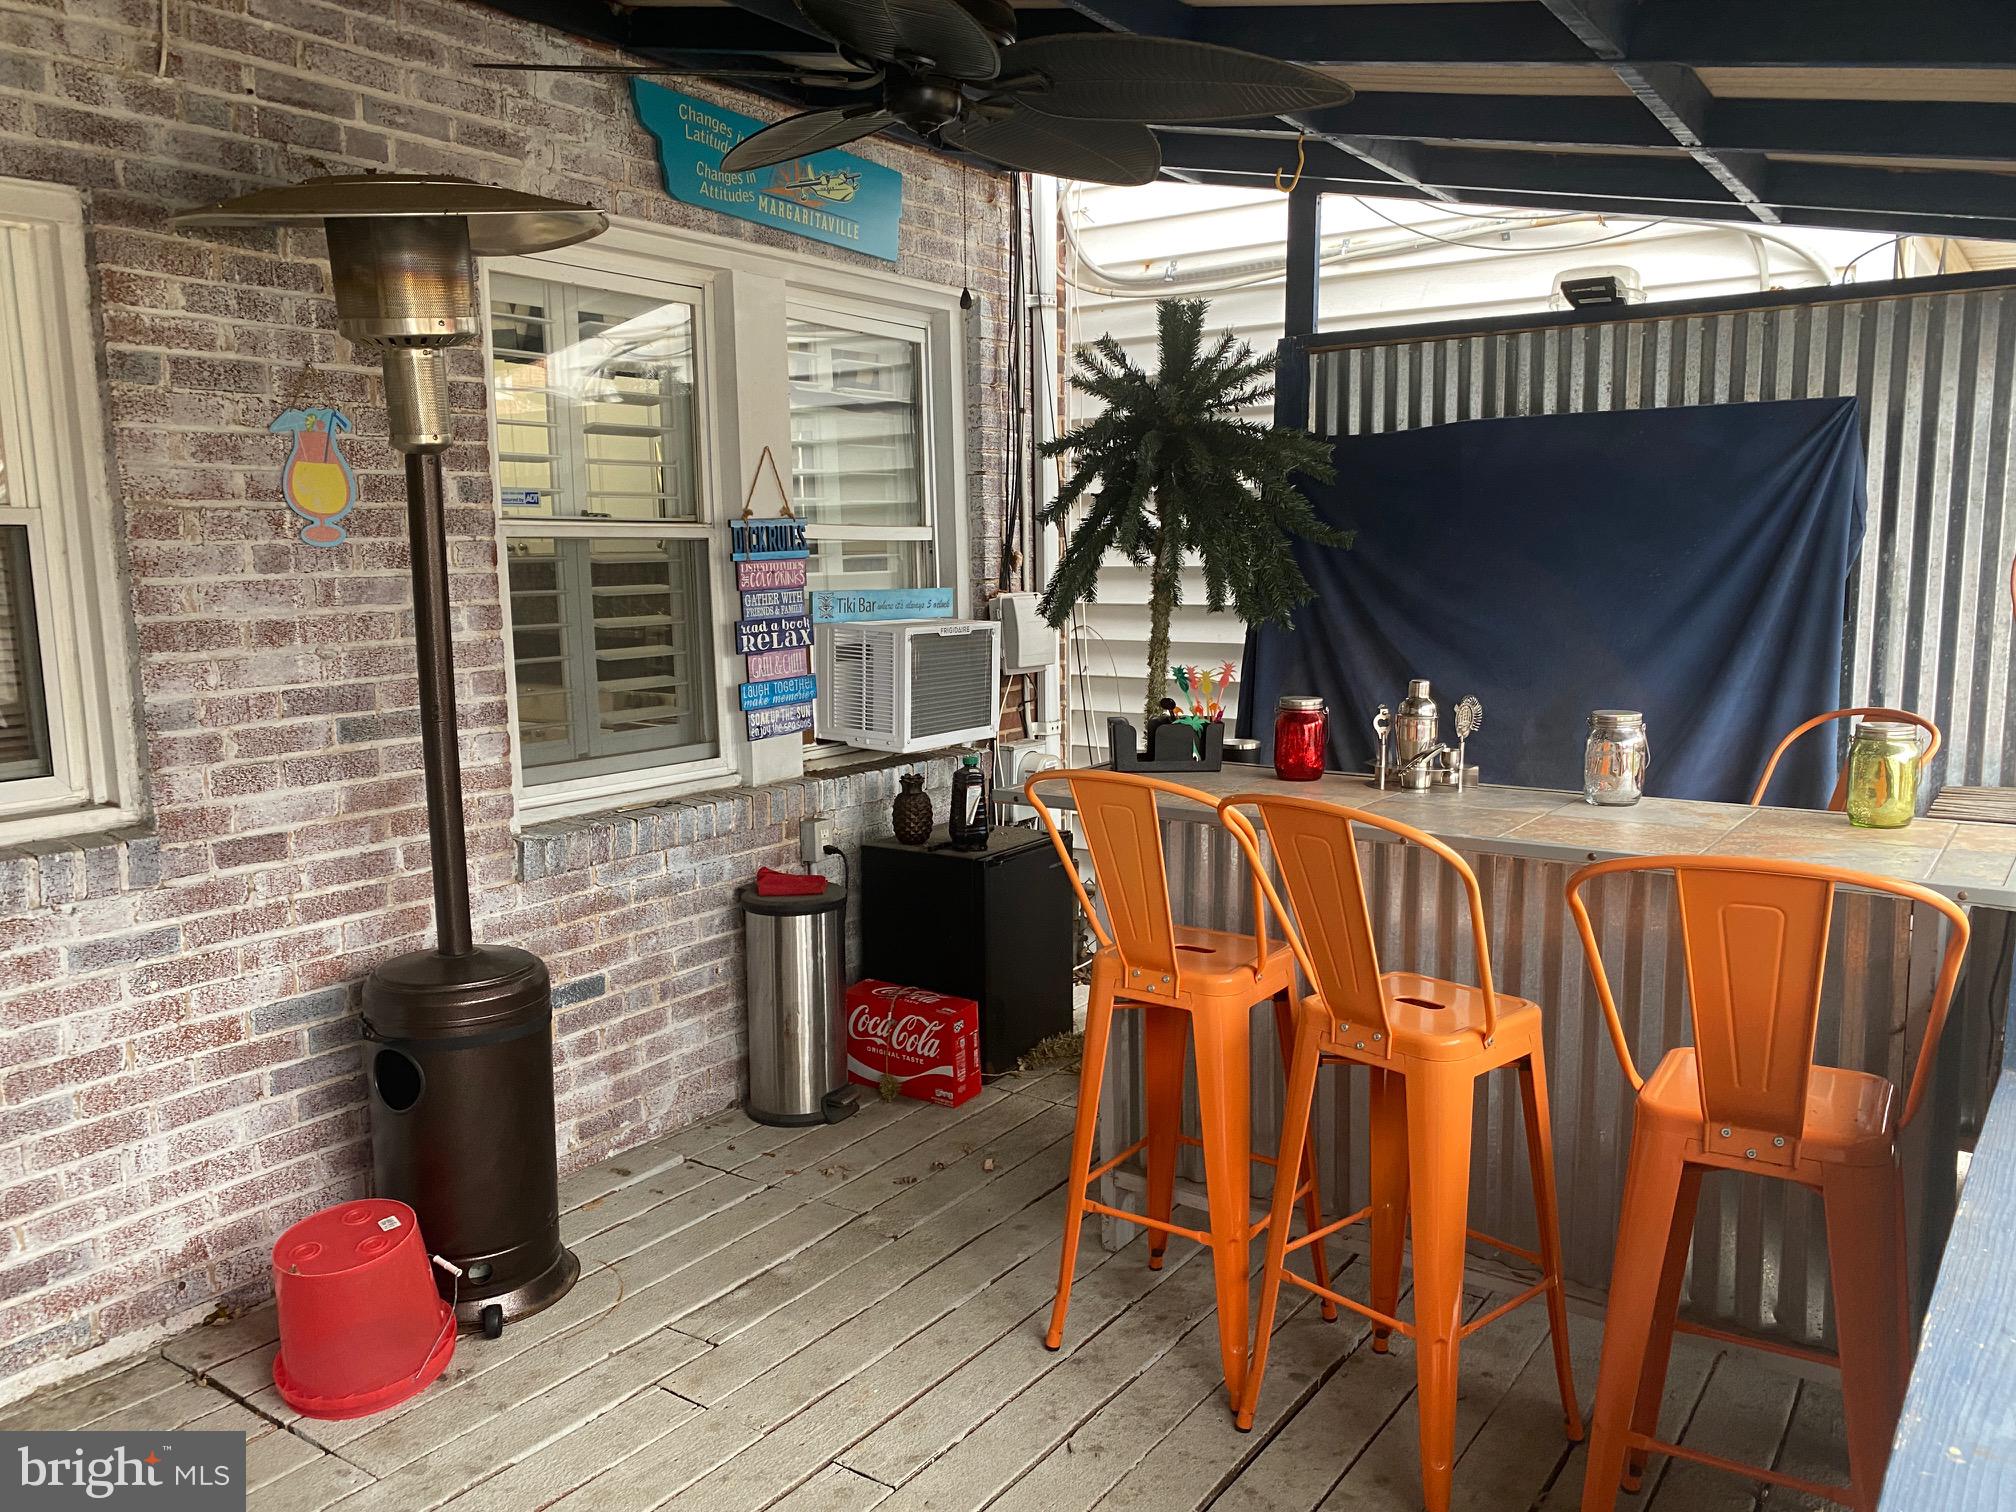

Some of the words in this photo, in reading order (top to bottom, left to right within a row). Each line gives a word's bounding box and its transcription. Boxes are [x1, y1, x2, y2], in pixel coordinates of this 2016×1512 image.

[678, 103, 733, 138] Changes
[685, 123, 732, 154] Latitud
[696, 160, 743, 186] Changes
[745, 171, 757, 183] in
[699, 181, 755, 203] Attitudes
[758, 195, 859, 240] MARGARITAVILLE
[731, 526, 768, 553] DCK
[744, 593, 780, 607] GATHER
[781, 591, 803, 604] WITH
[837, 597, 856, 614] Tiki
[859, 598, 876, 613] Bar
[746, 606, 774, 618] FRIENDS
[775, 606, 780, 615] &
[781, 604, 803, 614] FAMILY
[770, 622, 779, 631] a
[940, 625, 971, 636] FRIGIDAIRE
[752, 656, 774, 679] GRILL
[782, 652, 804, 674] CHILL
[743, 695, 769, 709] make
[796, 704, 811, 719] SUN
[866, 1046, 900, 1060] ORIGINAL
[901, 1053, 925, 1065] TASTE
